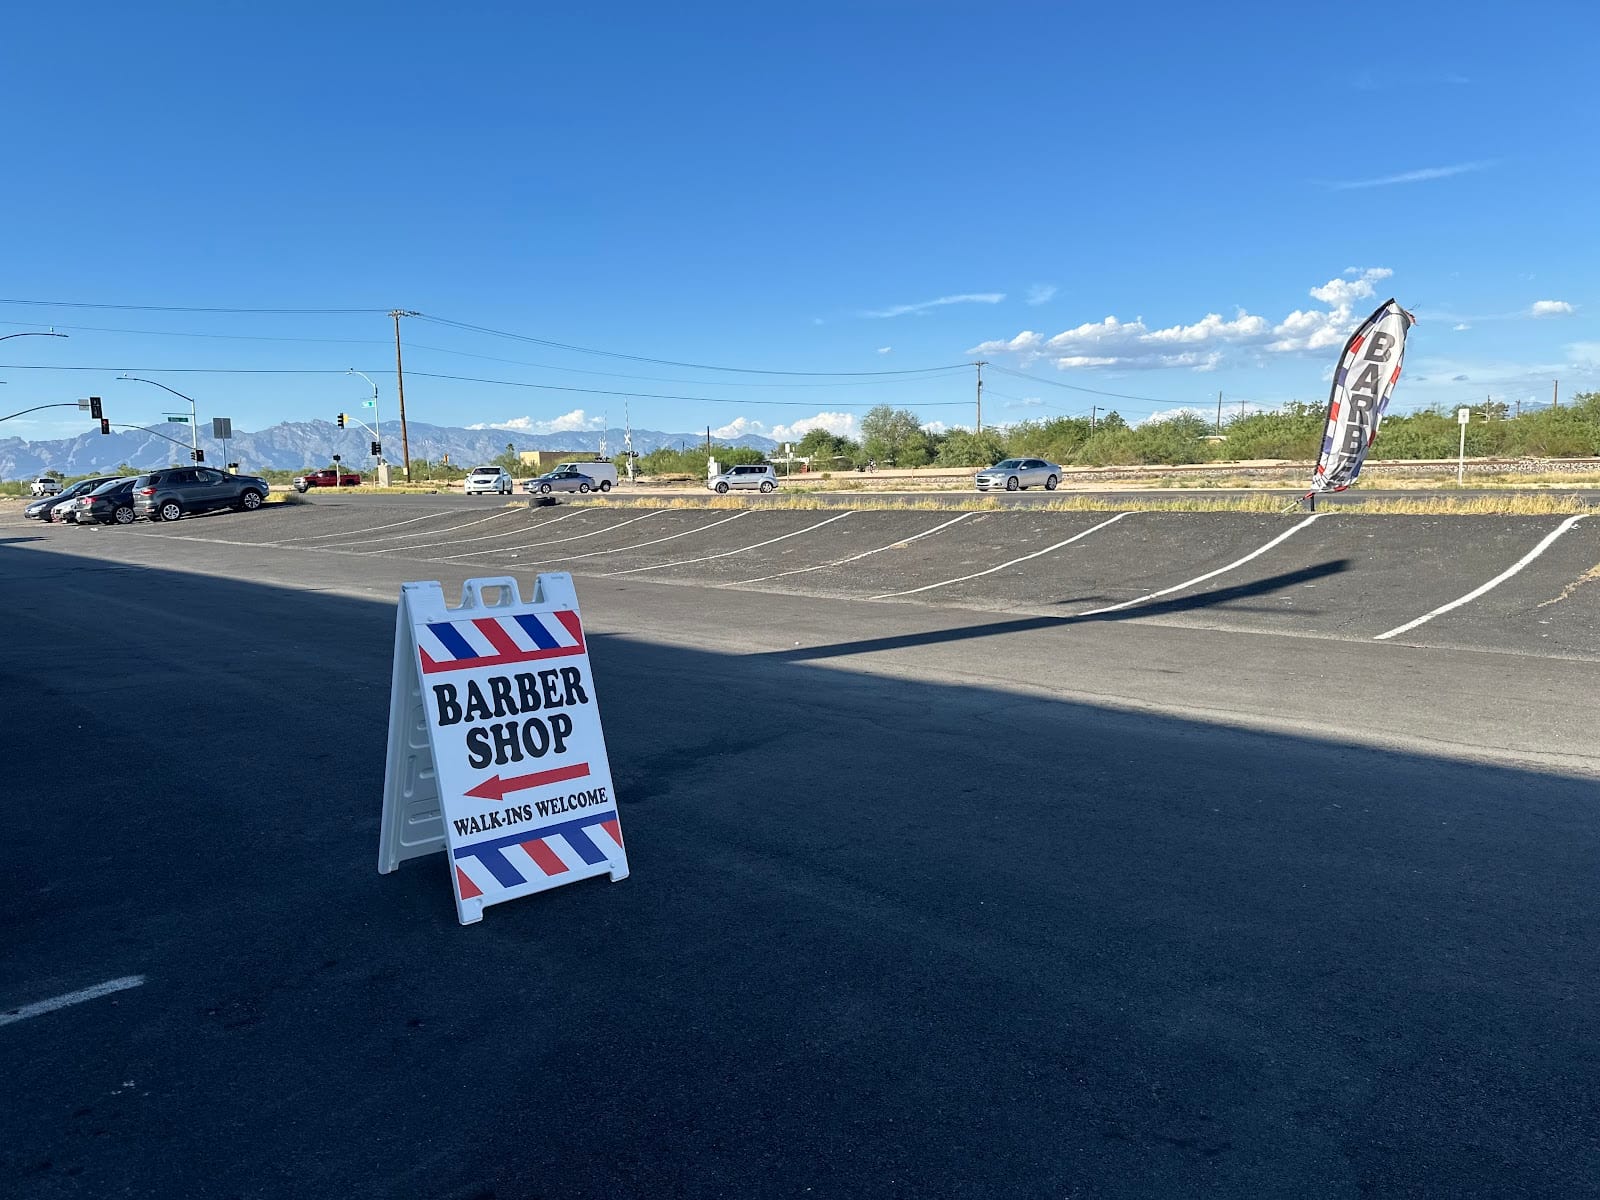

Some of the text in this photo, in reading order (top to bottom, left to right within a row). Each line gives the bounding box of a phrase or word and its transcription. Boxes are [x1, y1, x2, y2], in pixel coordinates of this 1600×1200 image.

[433, 666, 588, 726] BARBER
[466, 713, 573, 769] SHOP
[453, 787, 608, 837] WALK-INS WELCOME
